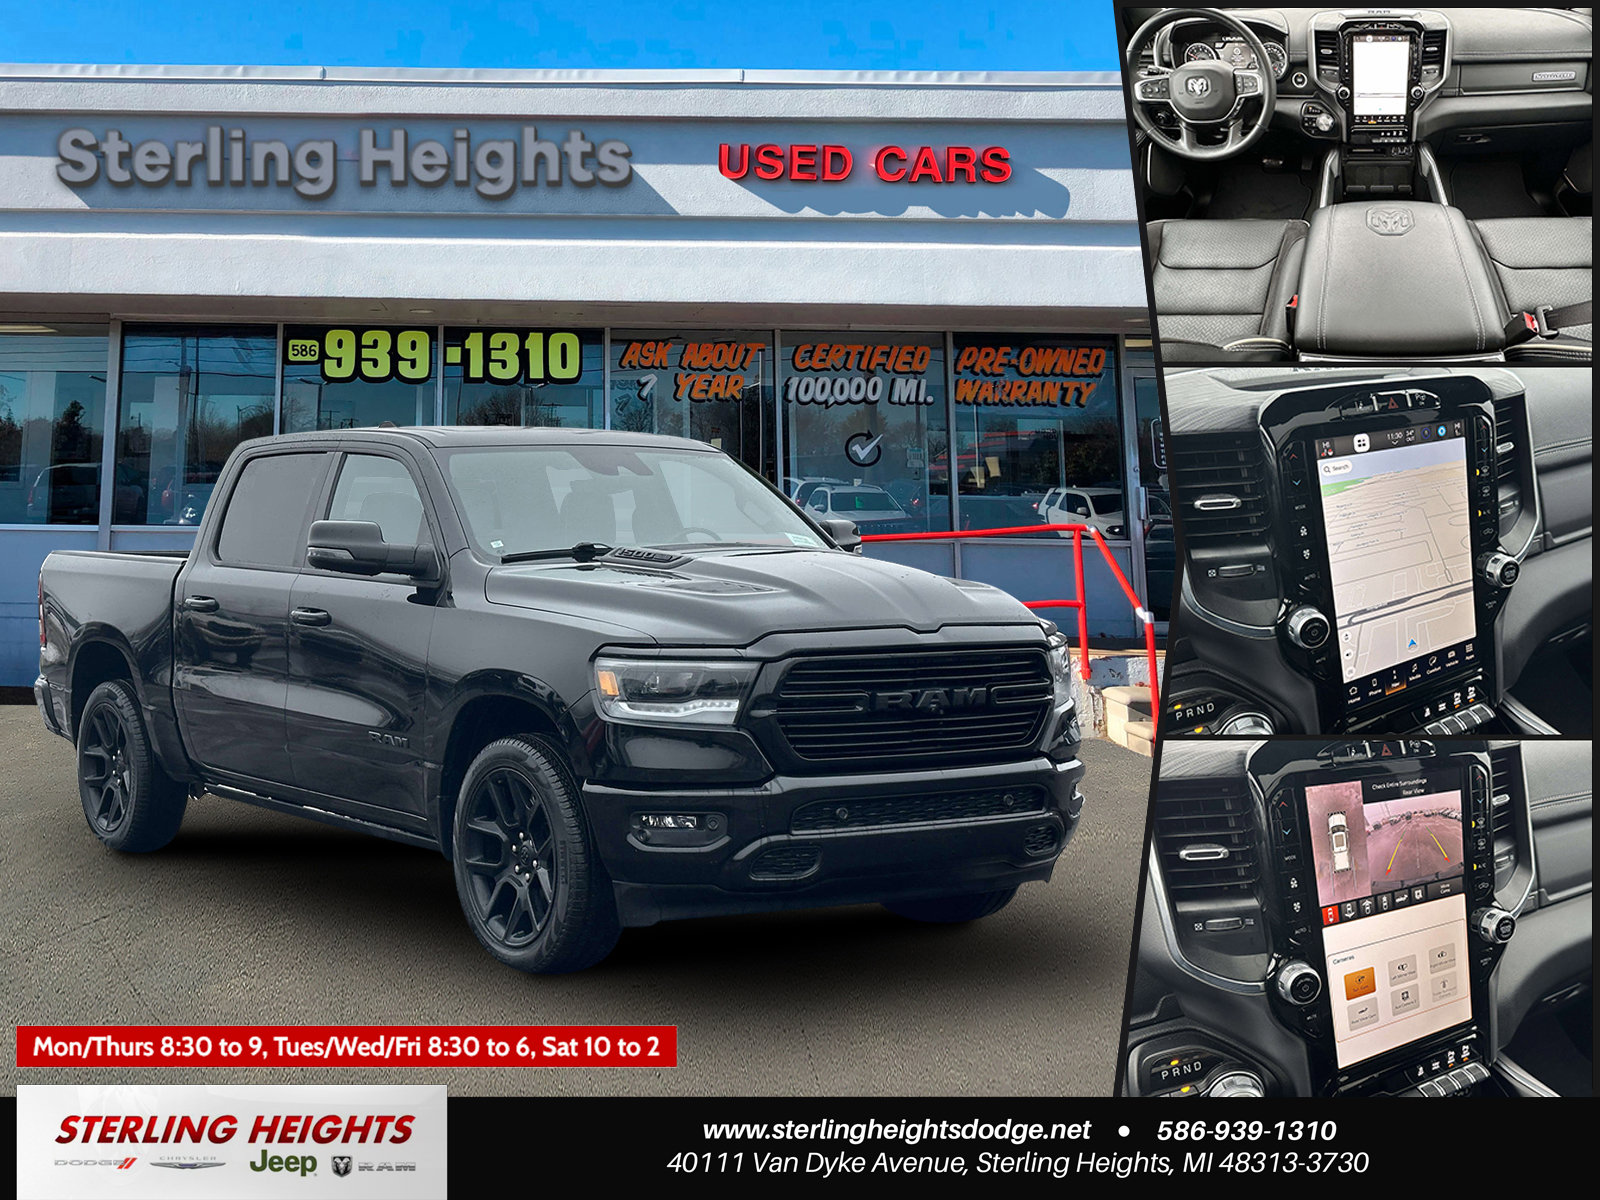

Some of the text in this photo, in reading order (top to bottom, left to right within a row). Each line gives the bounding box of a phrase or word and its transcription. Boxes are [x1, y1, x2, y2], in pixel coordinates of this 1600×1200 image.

[56, 126, 633, 200] Sterling Heights
[718, 143, 1012, 183] USED CARS
[292, 343, 318, 358] 586
[323, 328, 431, 379] 939
[619, 341, 766, 371] ASK ABOUT
[793, 343, 931, 373] CERTIFIED
[956, 345, 1106, 376] PRE-OWNED
[674, 373, 746, 402] YEAR
[785, 375, 935, 408] 100,000 MI.
[955, 378, 1097, 407] WARRANTY
[1332, 464, 1350, 472] Search
[876, 687, 988, 711] RAM
[368, 730, 409, 749] RAM
[1371, 783, 1386, 791] Check
[1413, 787, 1425, 795] View
[1332, 955, 1355, 965] Cameras
